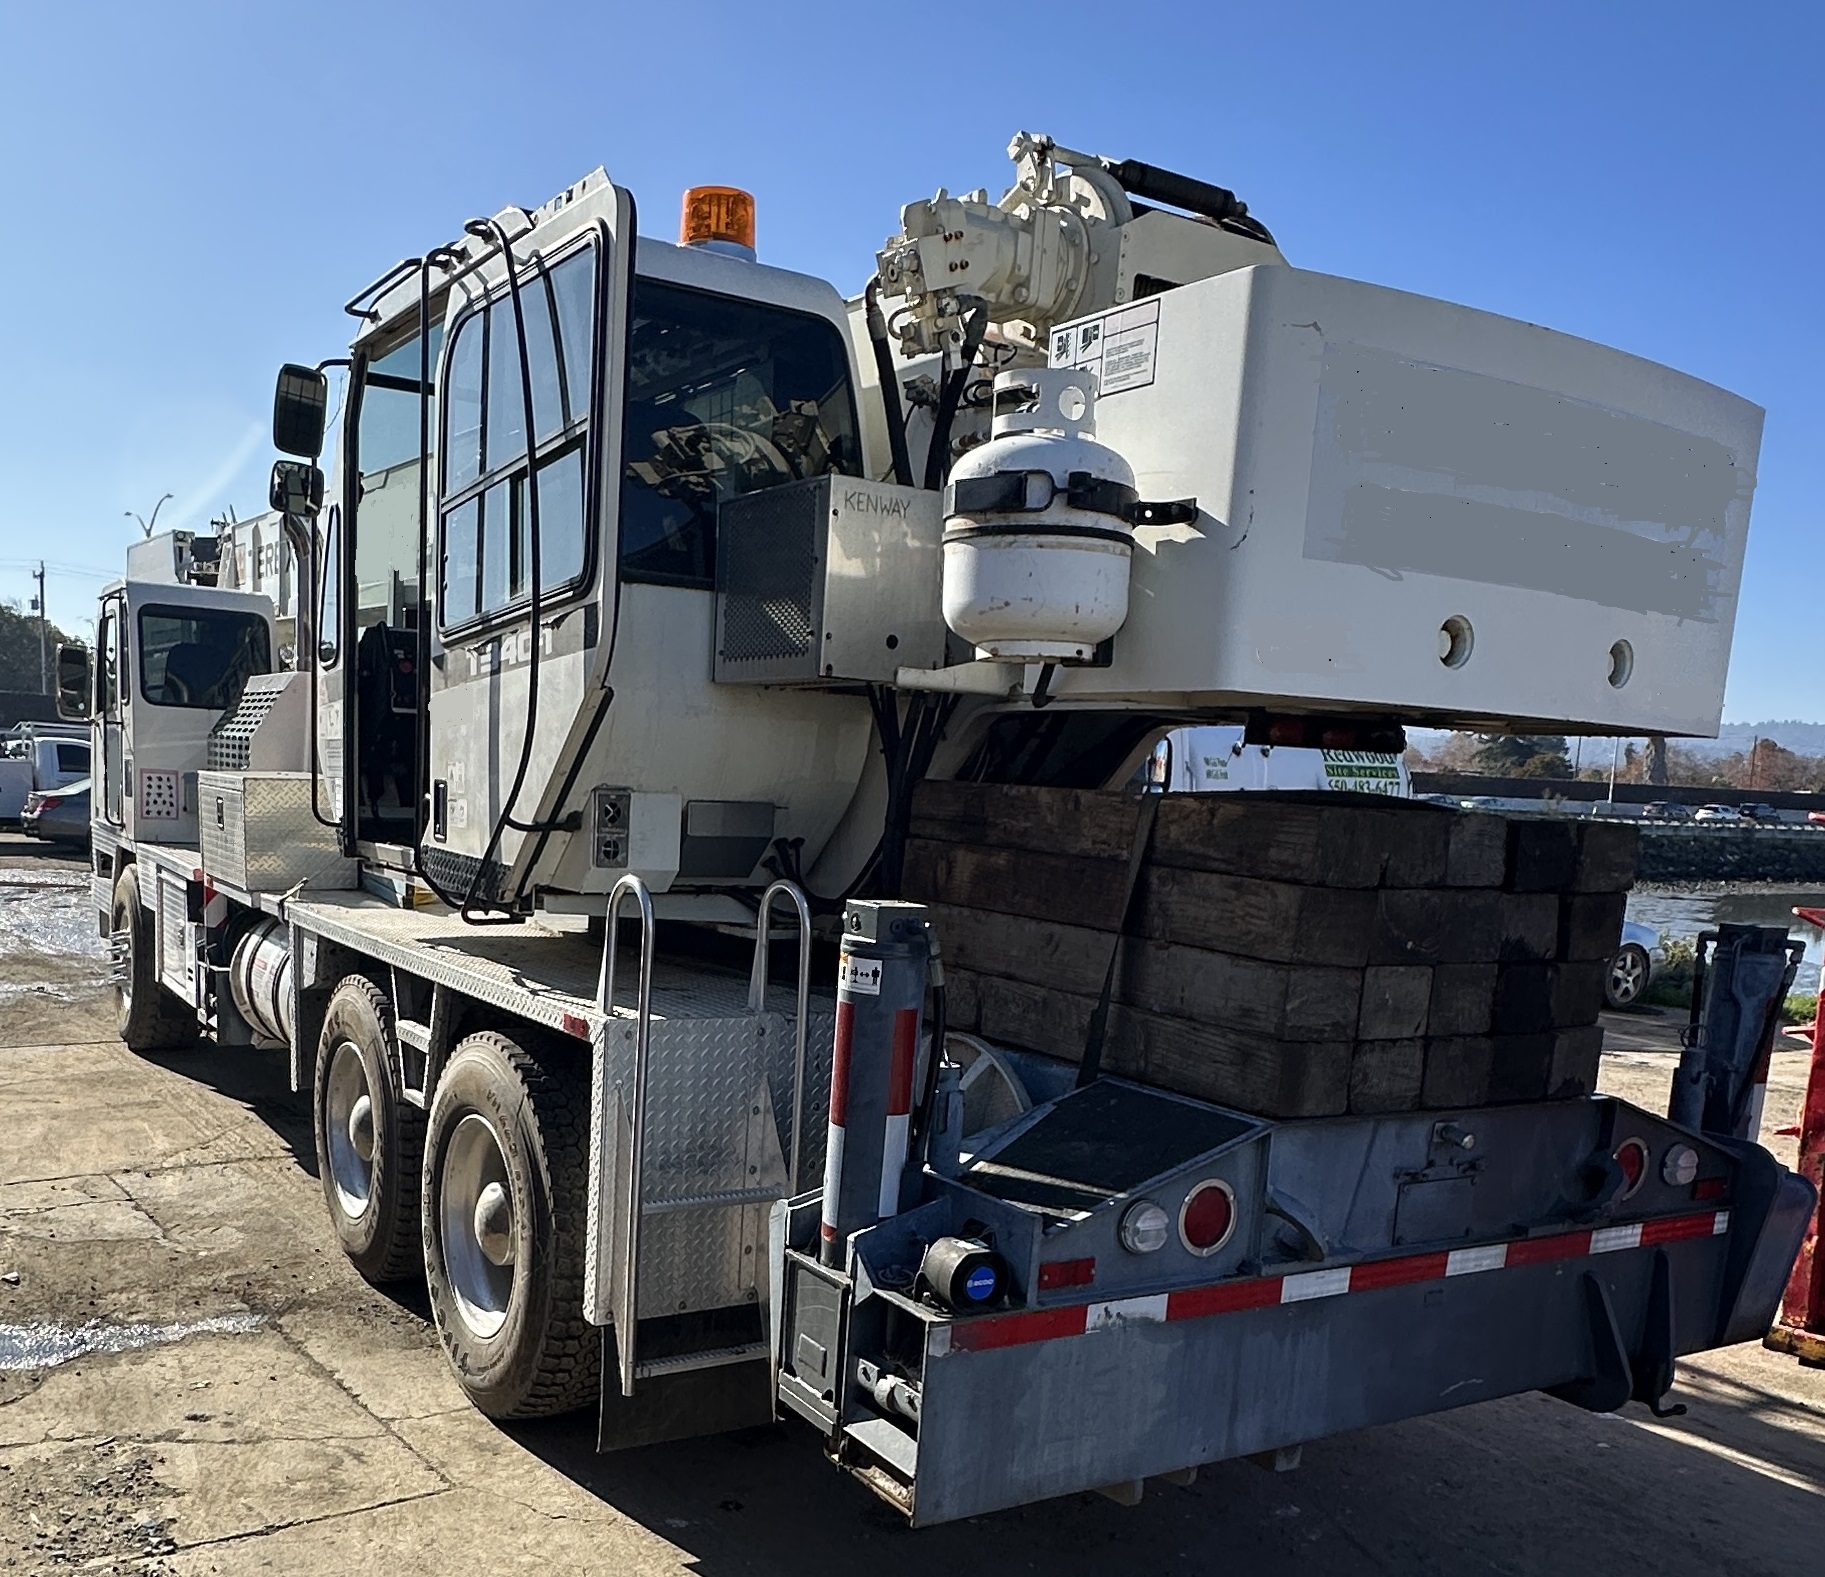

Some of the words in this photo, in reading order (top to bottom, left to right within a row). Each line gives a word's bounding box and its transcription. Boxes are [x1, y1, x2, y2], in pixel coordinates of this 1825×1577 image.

[844, 490, 910, 518] KENWAY
[1327, 766, 1348, 775] Site
[1352, 767, 1397, 777] Services
